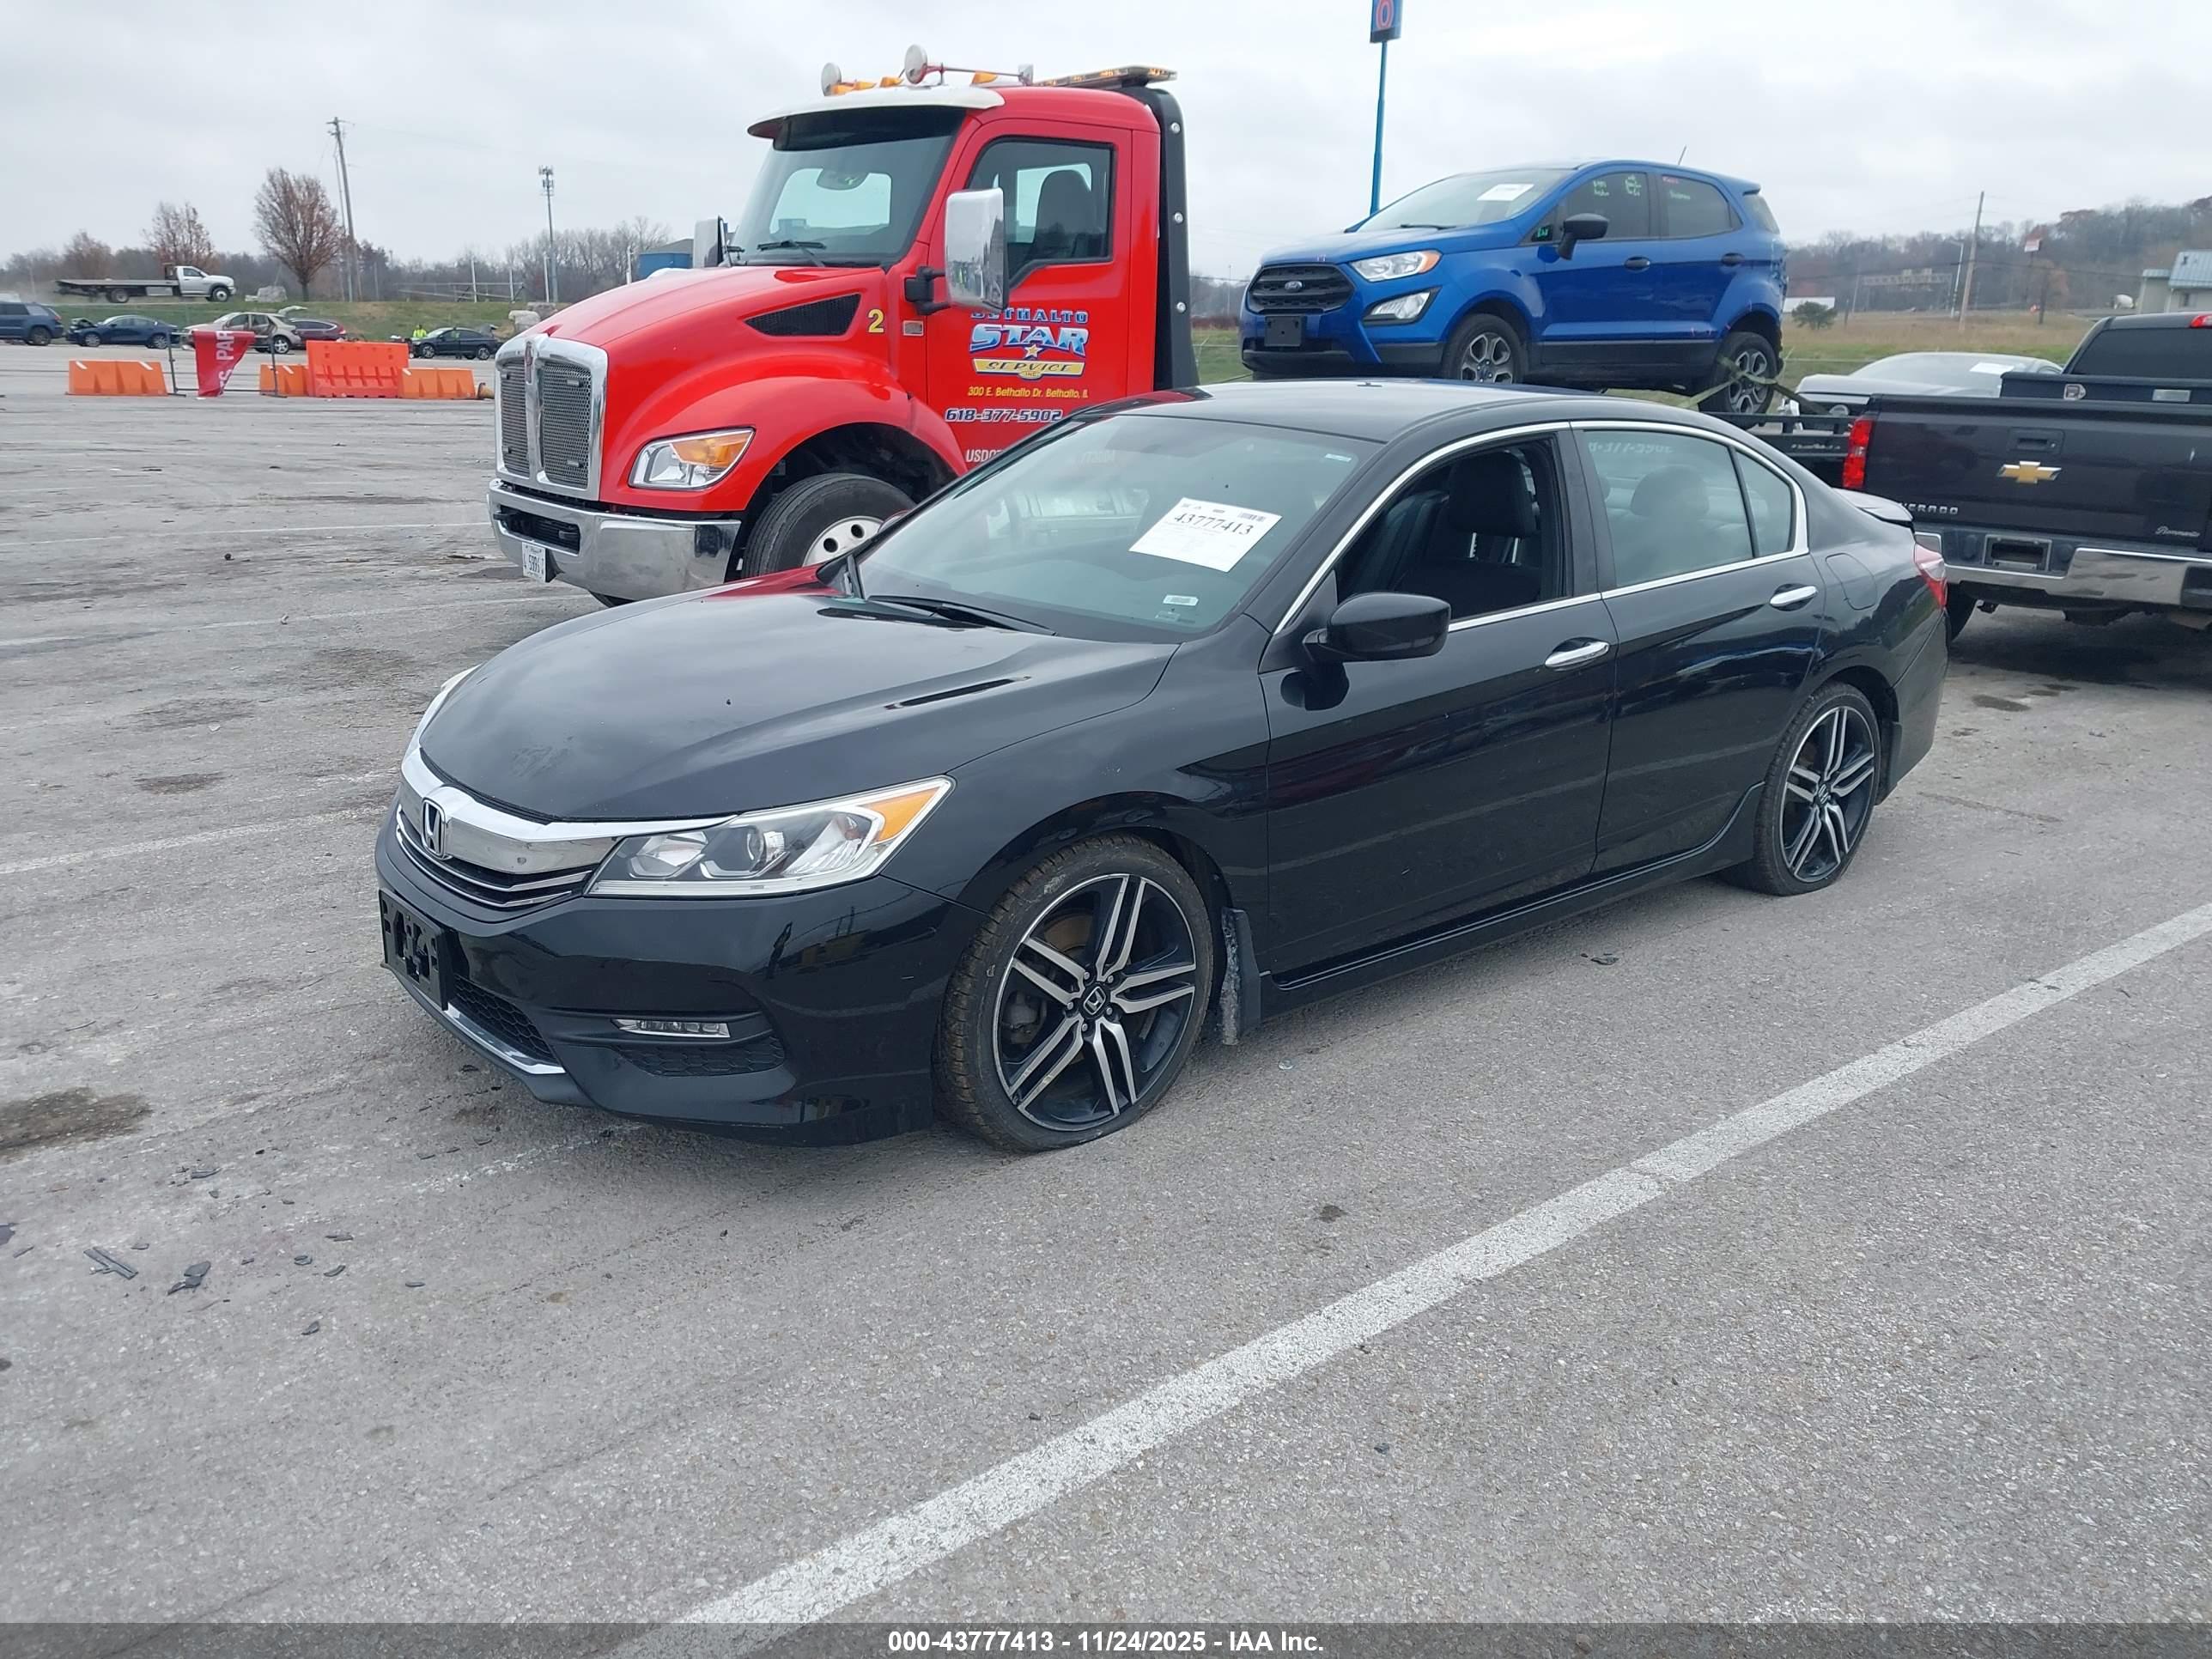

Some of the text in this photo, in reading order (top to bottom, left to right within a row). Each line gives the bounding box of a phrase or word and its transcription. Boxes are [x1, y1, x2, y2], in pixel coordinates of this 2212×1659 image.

[867, 308, 884, 333] 2
[969, 323, 1089, 358] STAR
[988, 362, 1073, 373] SERVICE
[968, 386, 984, 396] 300
[995, 386, 1030, 398] Bethalto
[945, 408, 1063, 422] 618-377-5902
[965, 449, 1003, 463] USDO
[1174, 513, 1255, 535] 43777413
